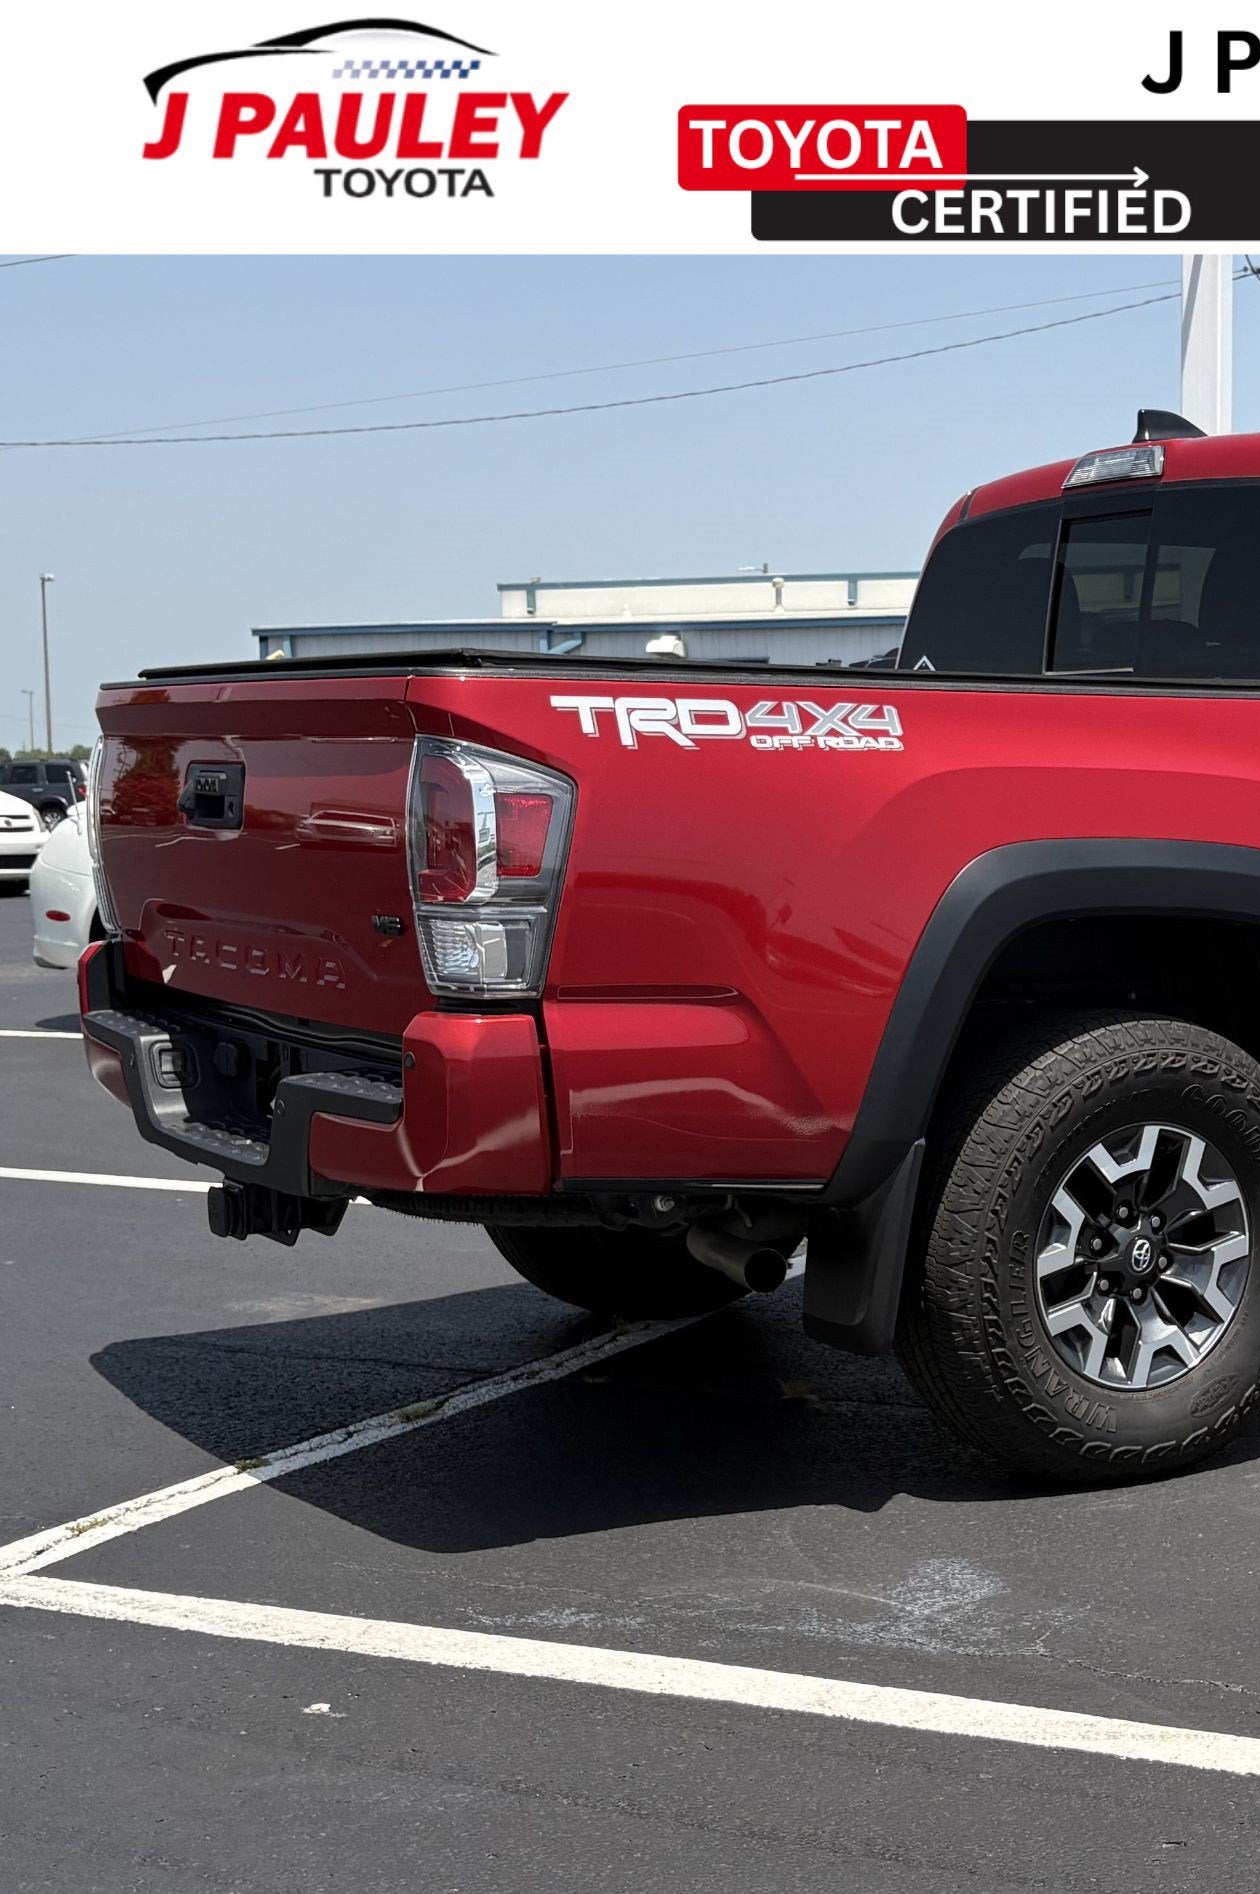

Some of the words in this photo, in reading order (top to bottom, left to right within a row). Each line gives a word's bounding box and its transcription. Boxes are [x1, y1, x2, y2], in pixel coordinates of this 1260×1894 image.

[550, 695, 746, 749] TRD
[750, 735, 815, 750] OFF
[817, 735, 904, 751] ROAD
[164, 928, 346, 989] TACOMA
[1009, 1230, 1118, 1434] WRANGLER
